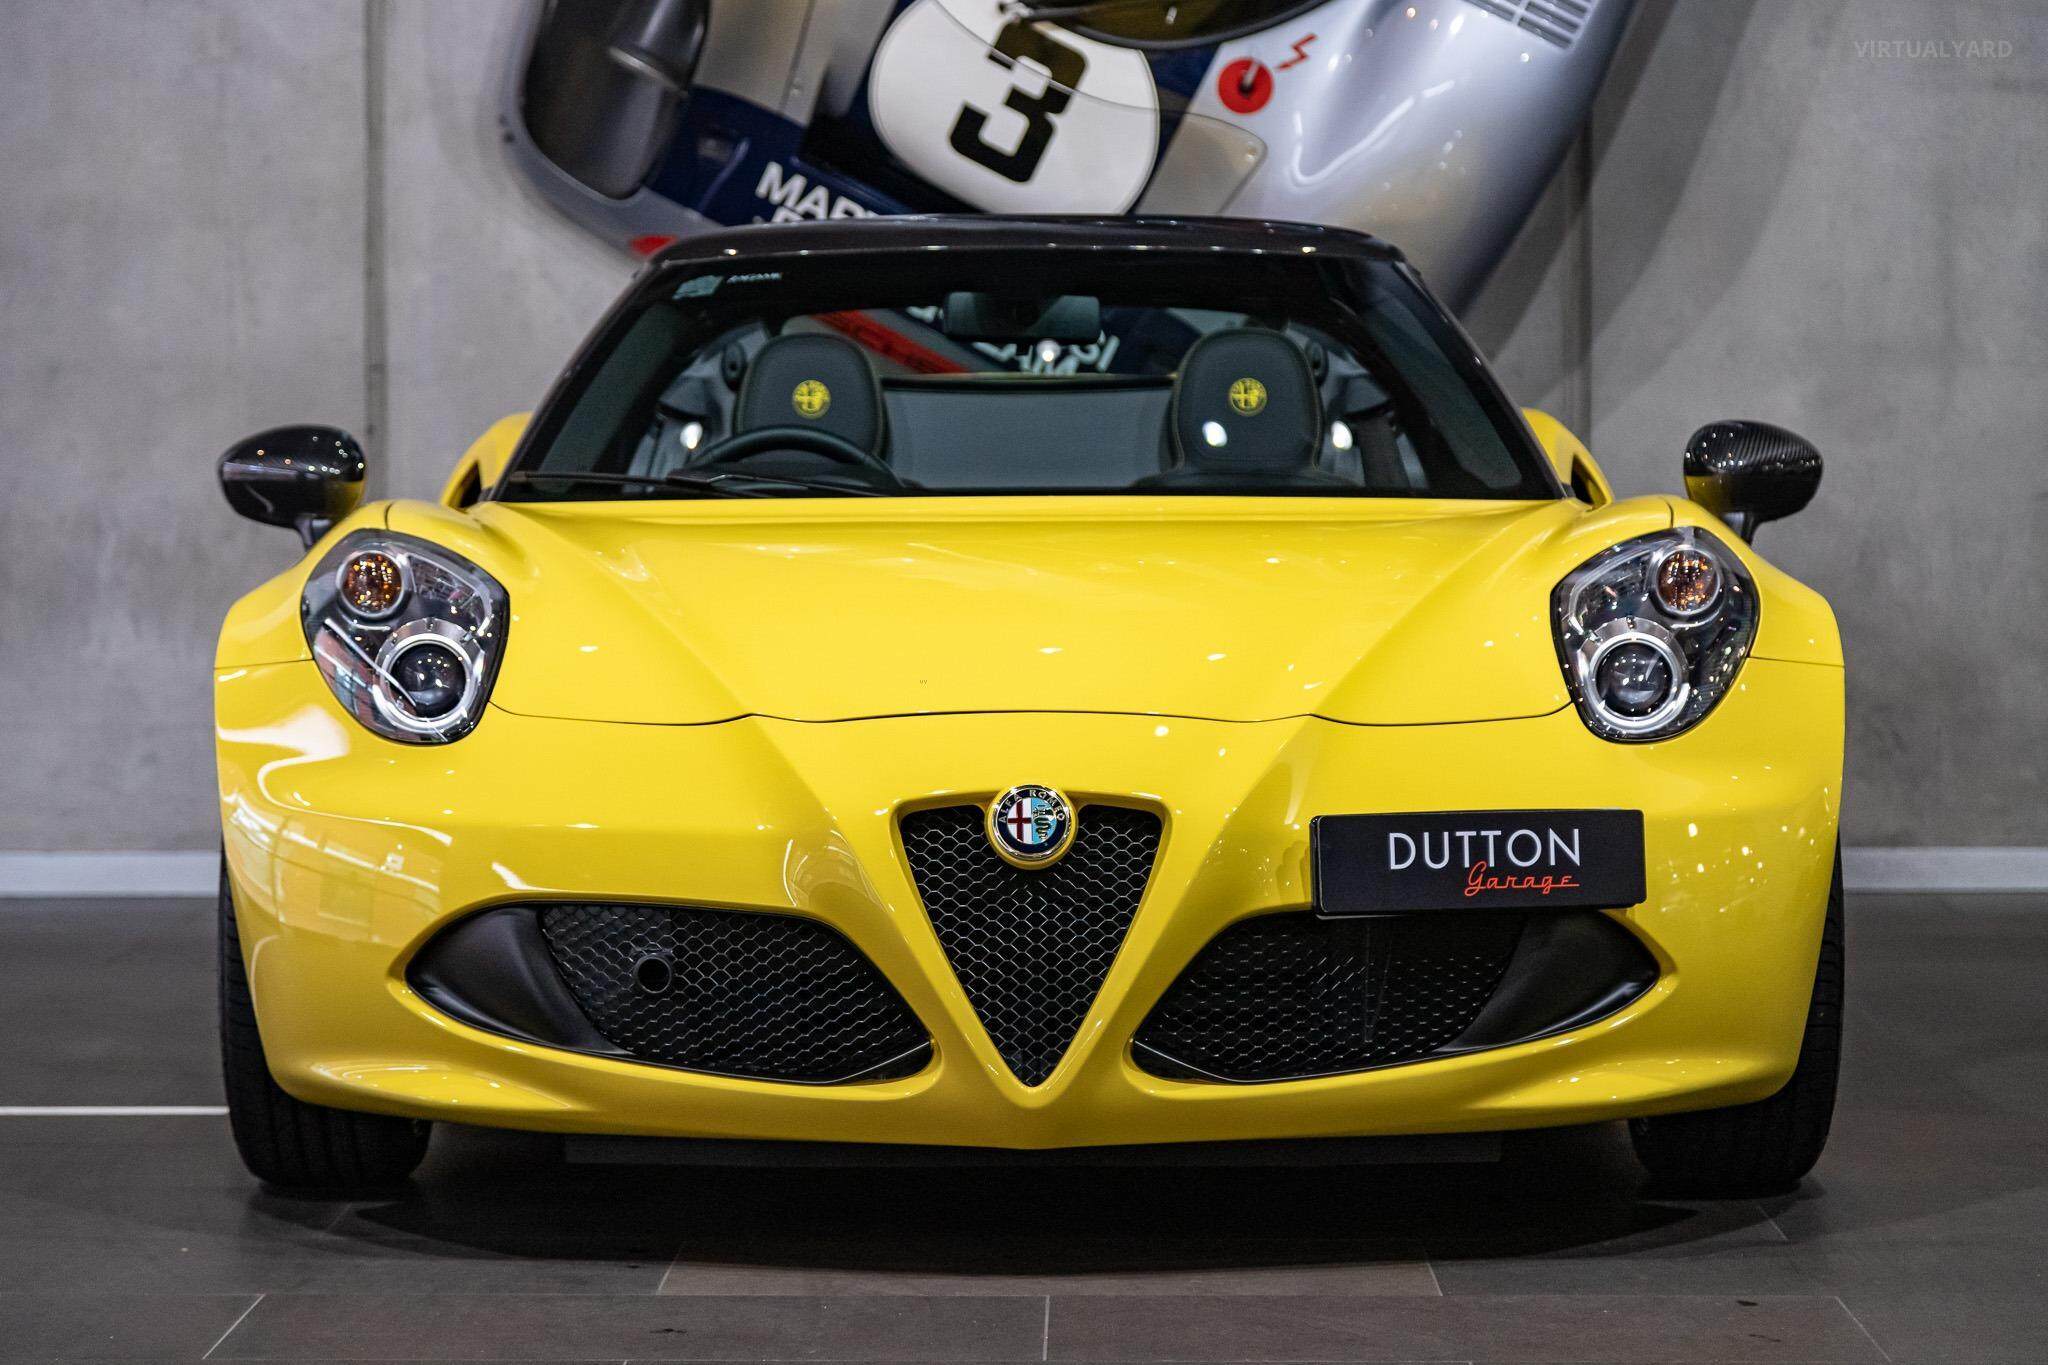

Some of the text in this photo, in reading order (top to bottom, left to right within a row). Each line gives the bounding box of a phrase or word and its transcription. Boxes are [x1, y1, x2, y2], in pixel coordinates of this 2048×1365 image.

[949, 18, 1088, 184] 3
[998, 789, 1065, 823] ALFA ROMEO
[1389, 828, 1580, 870] DUTTON
[1464, 861, 1580, 896] Garage
